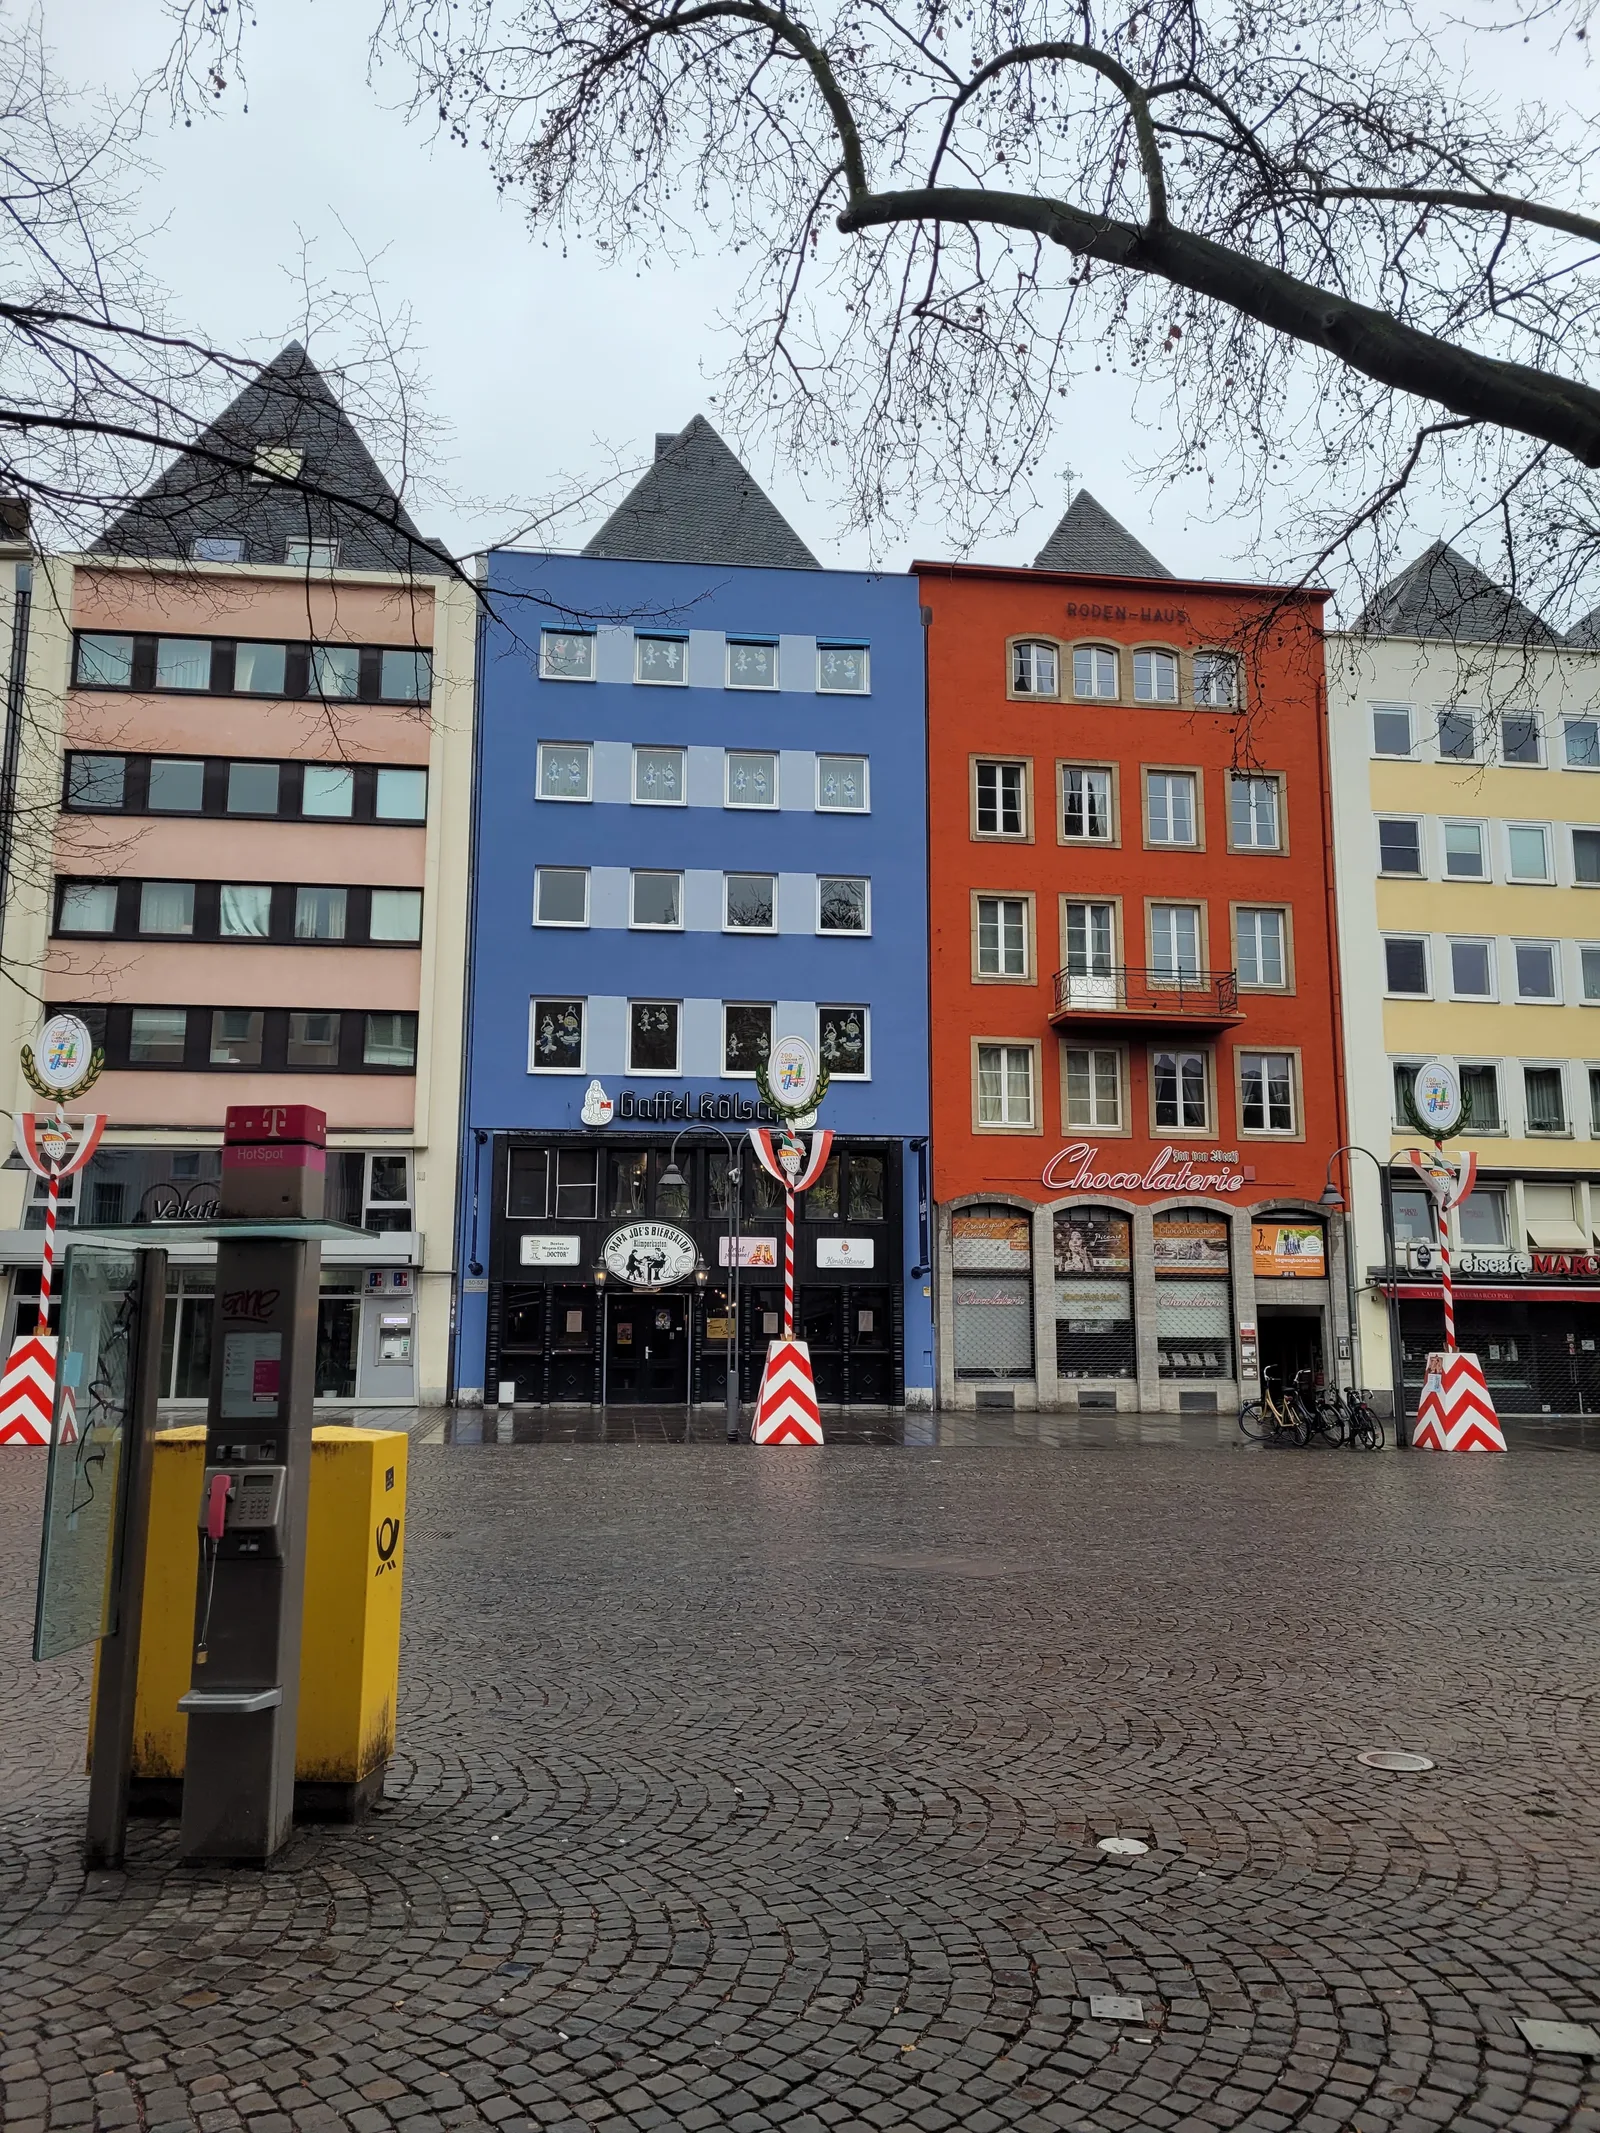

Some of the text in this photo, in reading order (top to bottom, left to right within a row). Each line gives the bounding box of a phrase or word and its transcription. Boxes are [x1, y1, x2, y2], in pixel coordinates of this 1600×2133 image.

[1066, 602, 1187, 624] RODEN-HAUS
[619, 1089, 693, 1122] Gaffel
[263, 1108, 286, 1136] T
[237, 1147, 284, 1161] HotSpot
[1042, 1142, 1244, 1192] Chocolaterie
[608, 1226, 692, 1254] PAPA JOE'S BIERSALON
